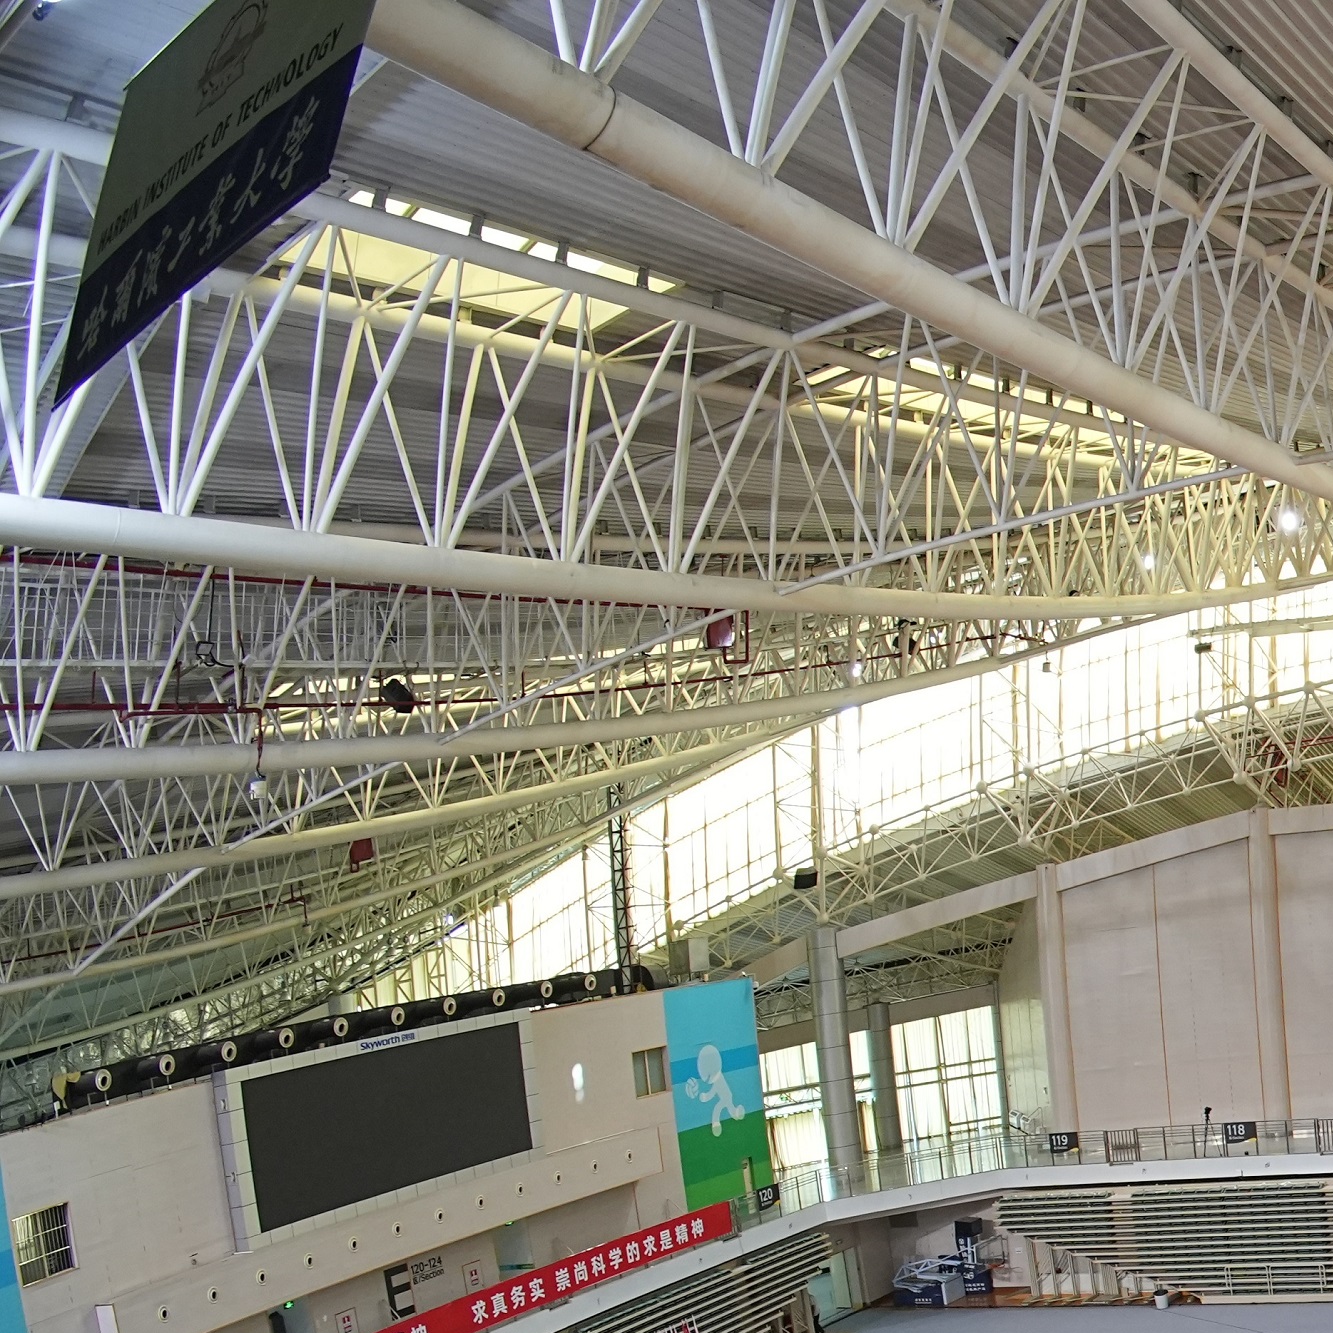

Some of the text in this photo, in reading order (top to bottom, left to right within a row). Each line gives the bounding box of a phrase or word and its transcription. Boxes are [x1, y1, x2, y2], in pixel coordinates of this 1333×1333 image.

[97, 22, 343, 256] HARBIN INSTITUTE OF TECHNOLOGY
[360, 1036, 401, 1050] Skyworth
[1226, 1124, 1246, 1136] 118
[1051, 1135, 1068, 1146] 119
[759, 1188, 773, 1202] 120
[410, 1256, 443, 1275] 120-124
[471, 1277, 546, 1325] 求真务实
[555, 1217, 704, 1292] 崇尚科学的求是精神
[383, 1263, 416, 1321] E
